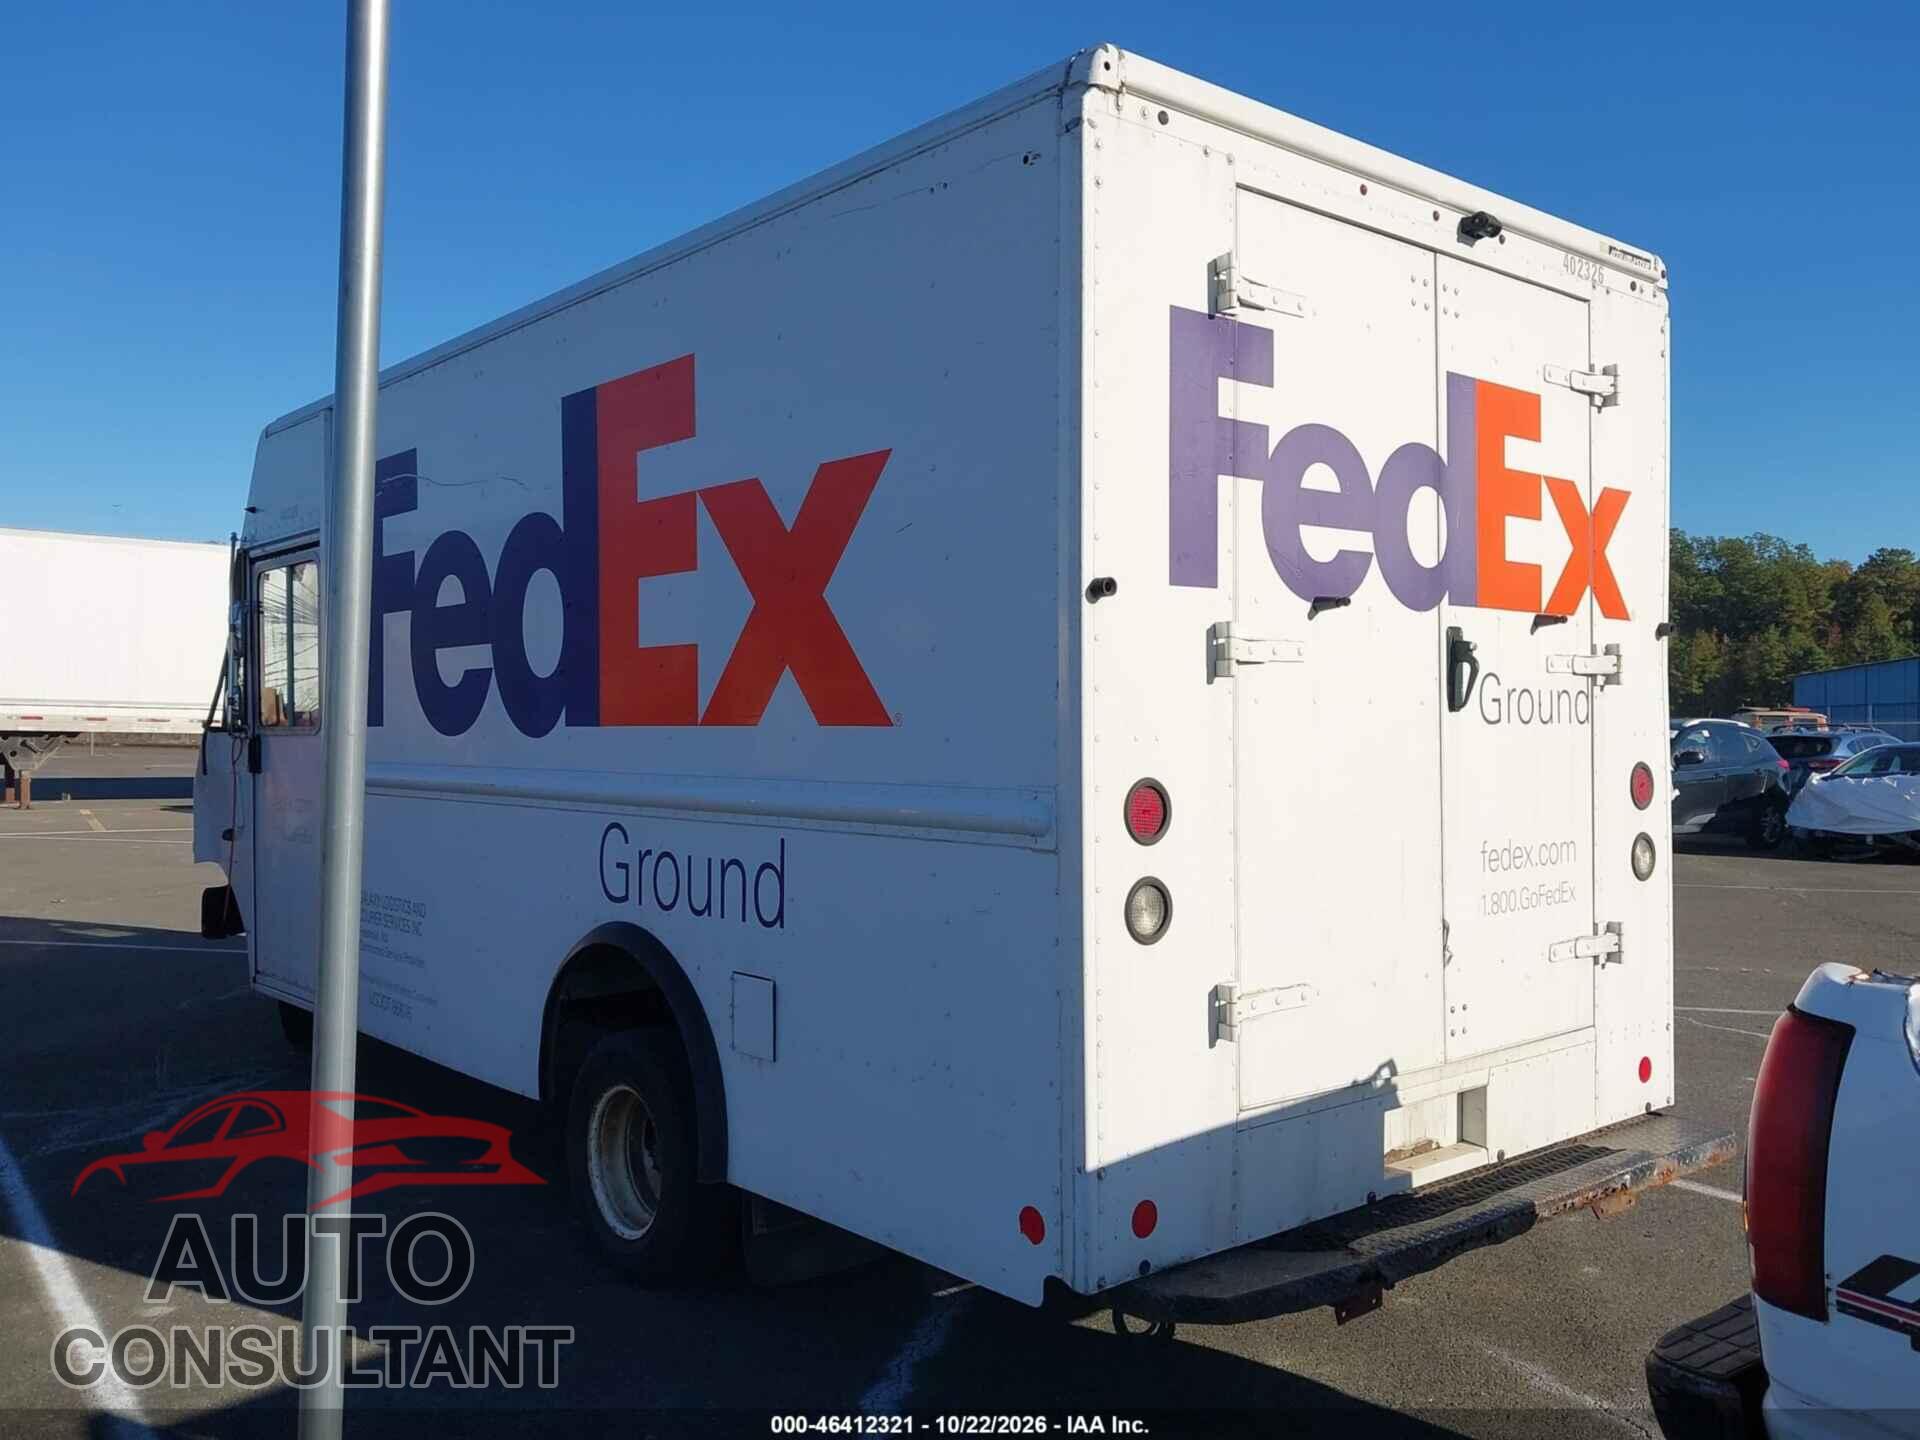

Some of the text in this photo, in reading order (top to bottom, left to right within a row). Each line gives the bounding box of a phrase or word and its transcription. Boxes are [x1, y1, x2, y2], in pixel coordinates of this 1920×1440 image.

[1562, 253, 1605, 285] 402326
[1169, 304, 1632, 621] FedEx
[1480, 671, 1590, 725] Ground
[600, 821, 785, 929] Ground
[1481, 838, 1577, 873] fedex.com
